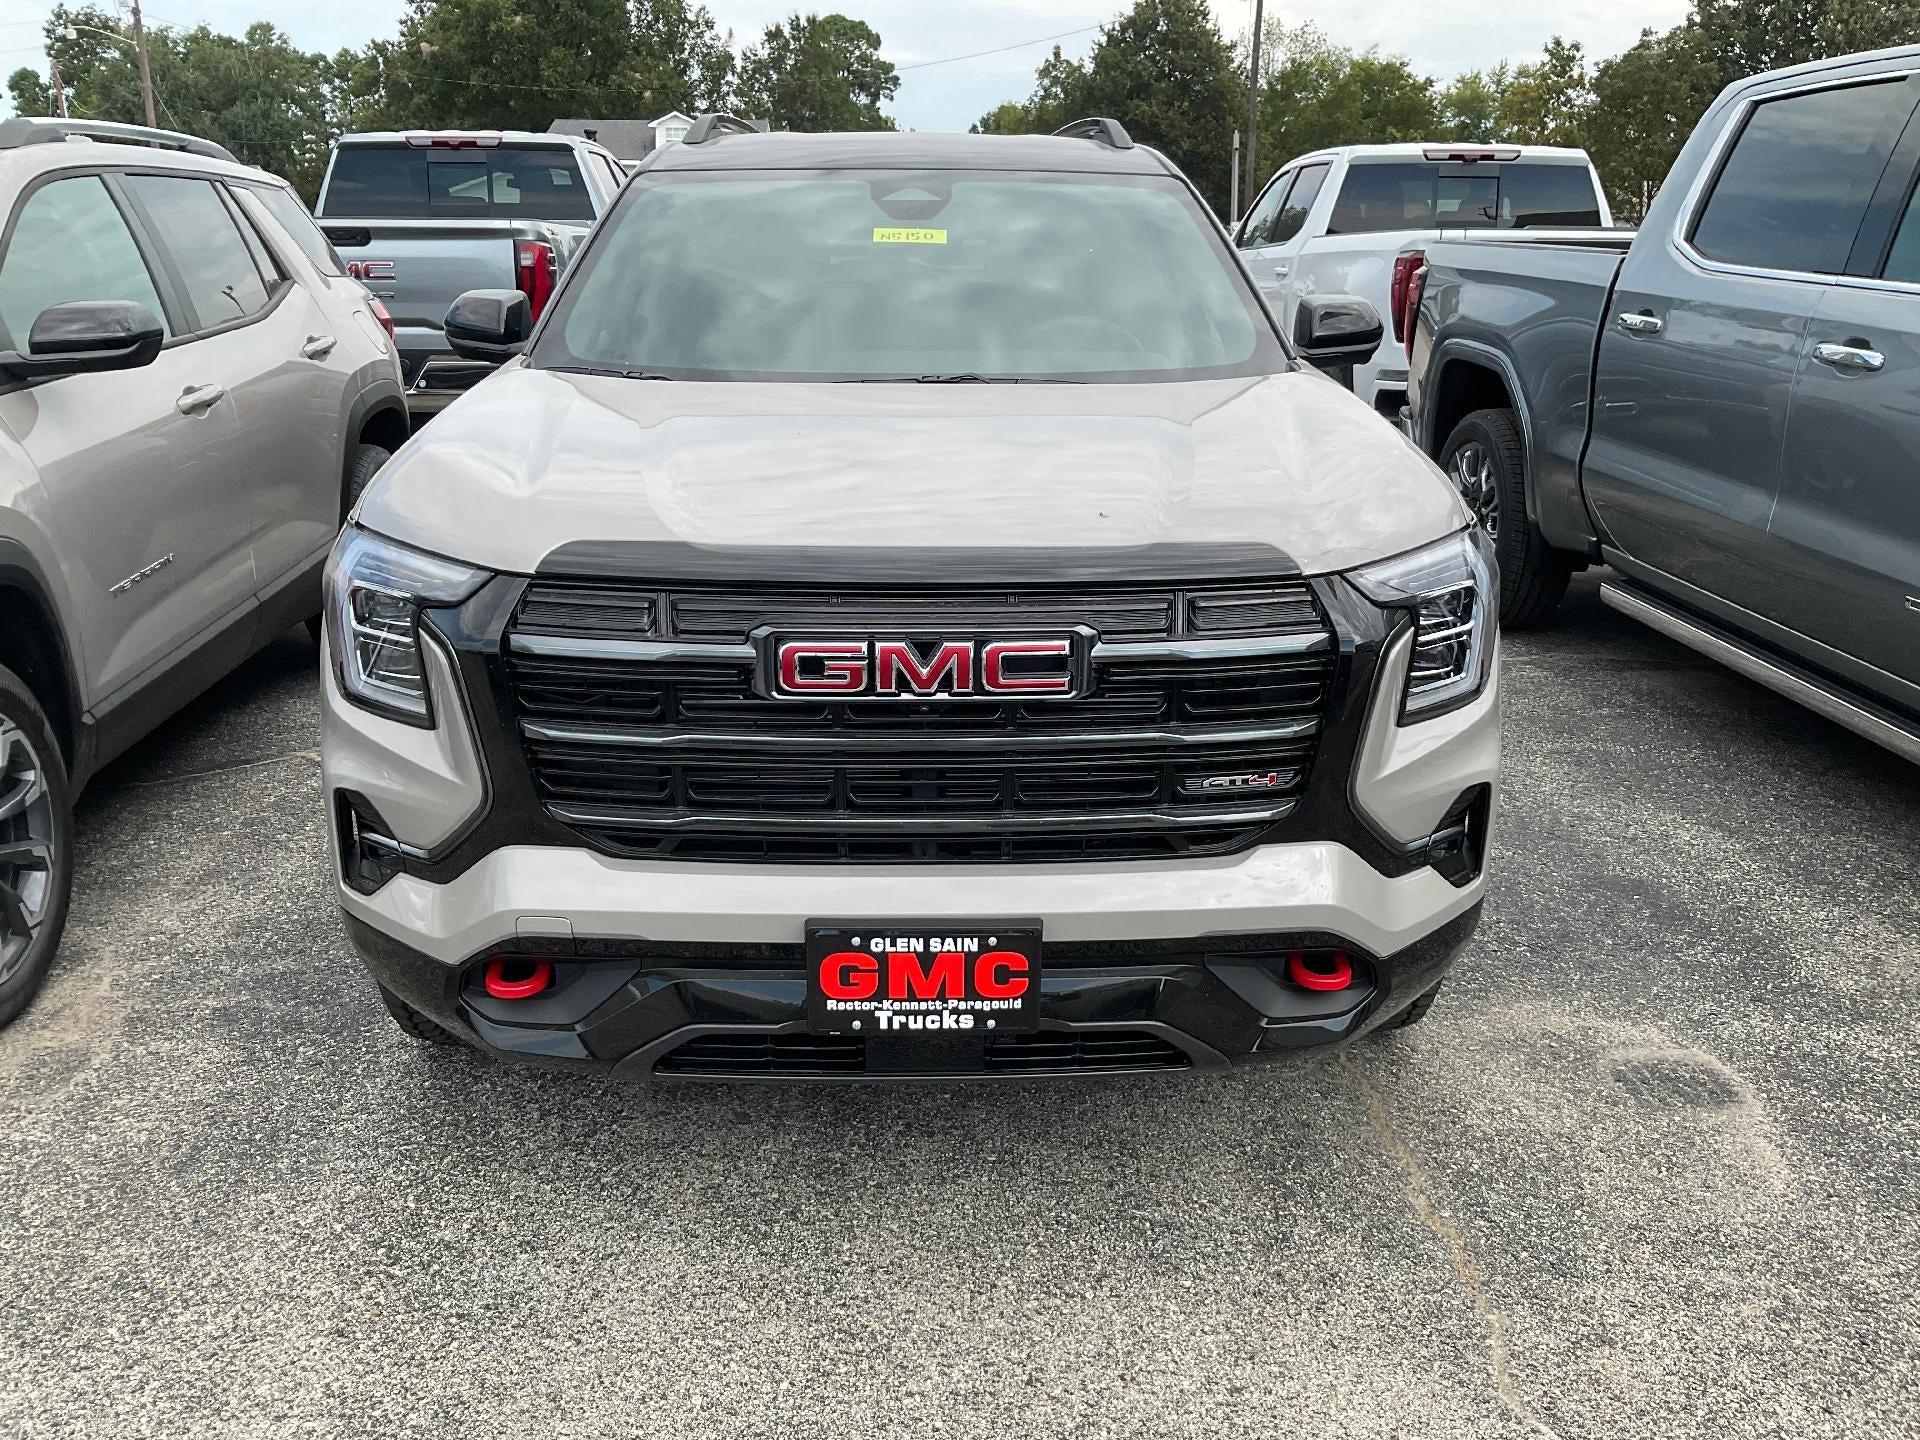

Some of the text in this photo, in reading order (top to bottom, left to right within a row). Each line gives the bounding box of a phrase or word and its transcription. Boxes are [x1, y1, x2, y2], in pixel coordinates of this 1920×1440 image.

[778, 640, 1071, 694] GMC
[1202, 772, 1278, 788] AT4
[870, 937, 979, 953] GLEN SAIN
[819, 951, 1030, 999] GMC
[874, 1010, 975, 1030] Trucks
